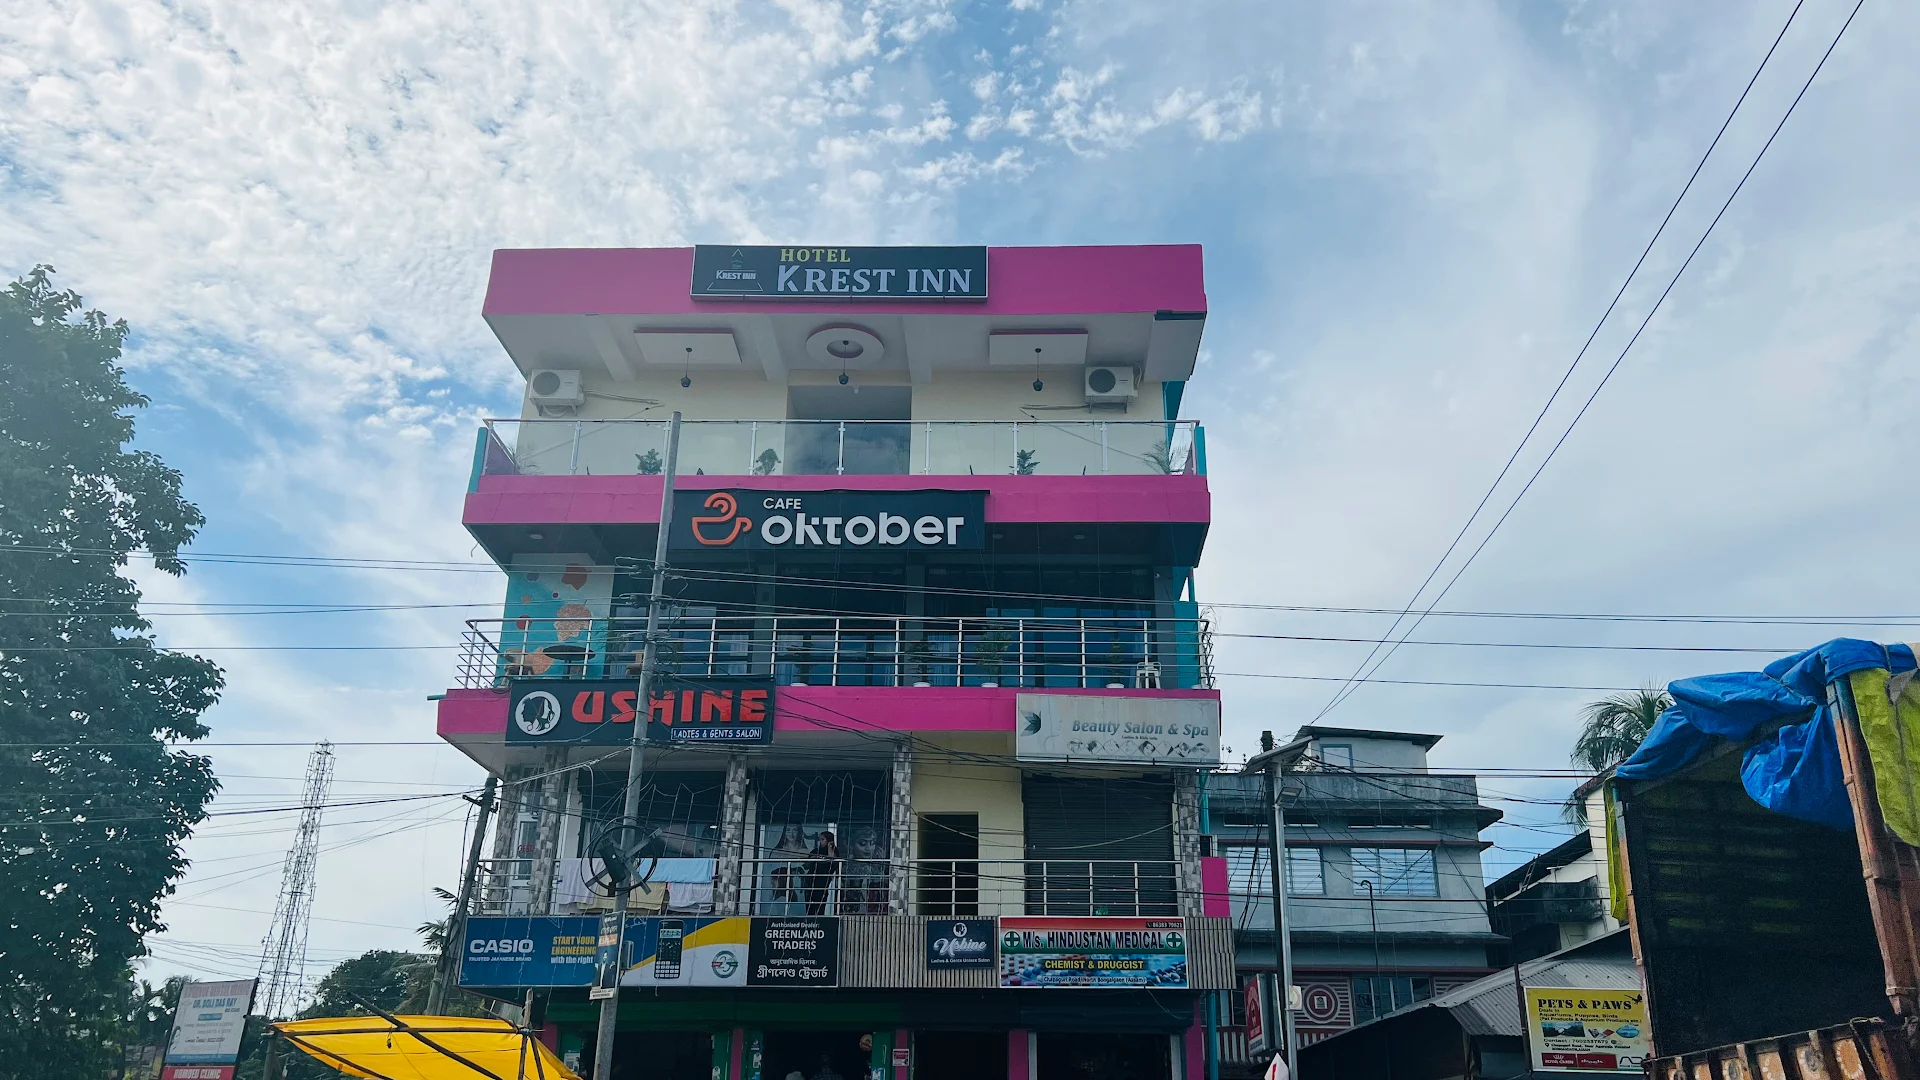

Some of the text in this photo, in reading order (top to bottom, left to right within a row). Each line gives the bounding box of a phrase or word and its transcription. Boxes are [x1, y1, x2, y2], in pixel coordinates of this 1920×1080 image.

[780, 248, 851, 262] HOTEL
[715, 269, 756, 280] KREST INN
[777, 264, 973, 293] KREST INN
[763, 498, 802, 510] CAFE
[761, 512, 965, 545] oktober
[571, 690, 768, 726] USHINE
[673, 729, 760, 739] LADIES & GENTS SALON
[1072, 720, 1209, 738] Beauty Salon & Spa
[553, 936, 575, 945] START
[576, 936, 595, 945] YOUR
[765, 930, 825, 939] GREENLAND
[1023, 931, 1164, 949] M/s. HINDUSTAN MEDICAL
[470, 939, 534, 953] CASIO
[551, 946, 597, 955] ENGINEERING
[771, 940, 817, 950] TRADERS
[550, 955, 594, 964] with the right
[1045, 960, 1144, 969] CHEMIST & DRUGGIST
[1537, 998, 1632, 1010] PETS & PAWS
